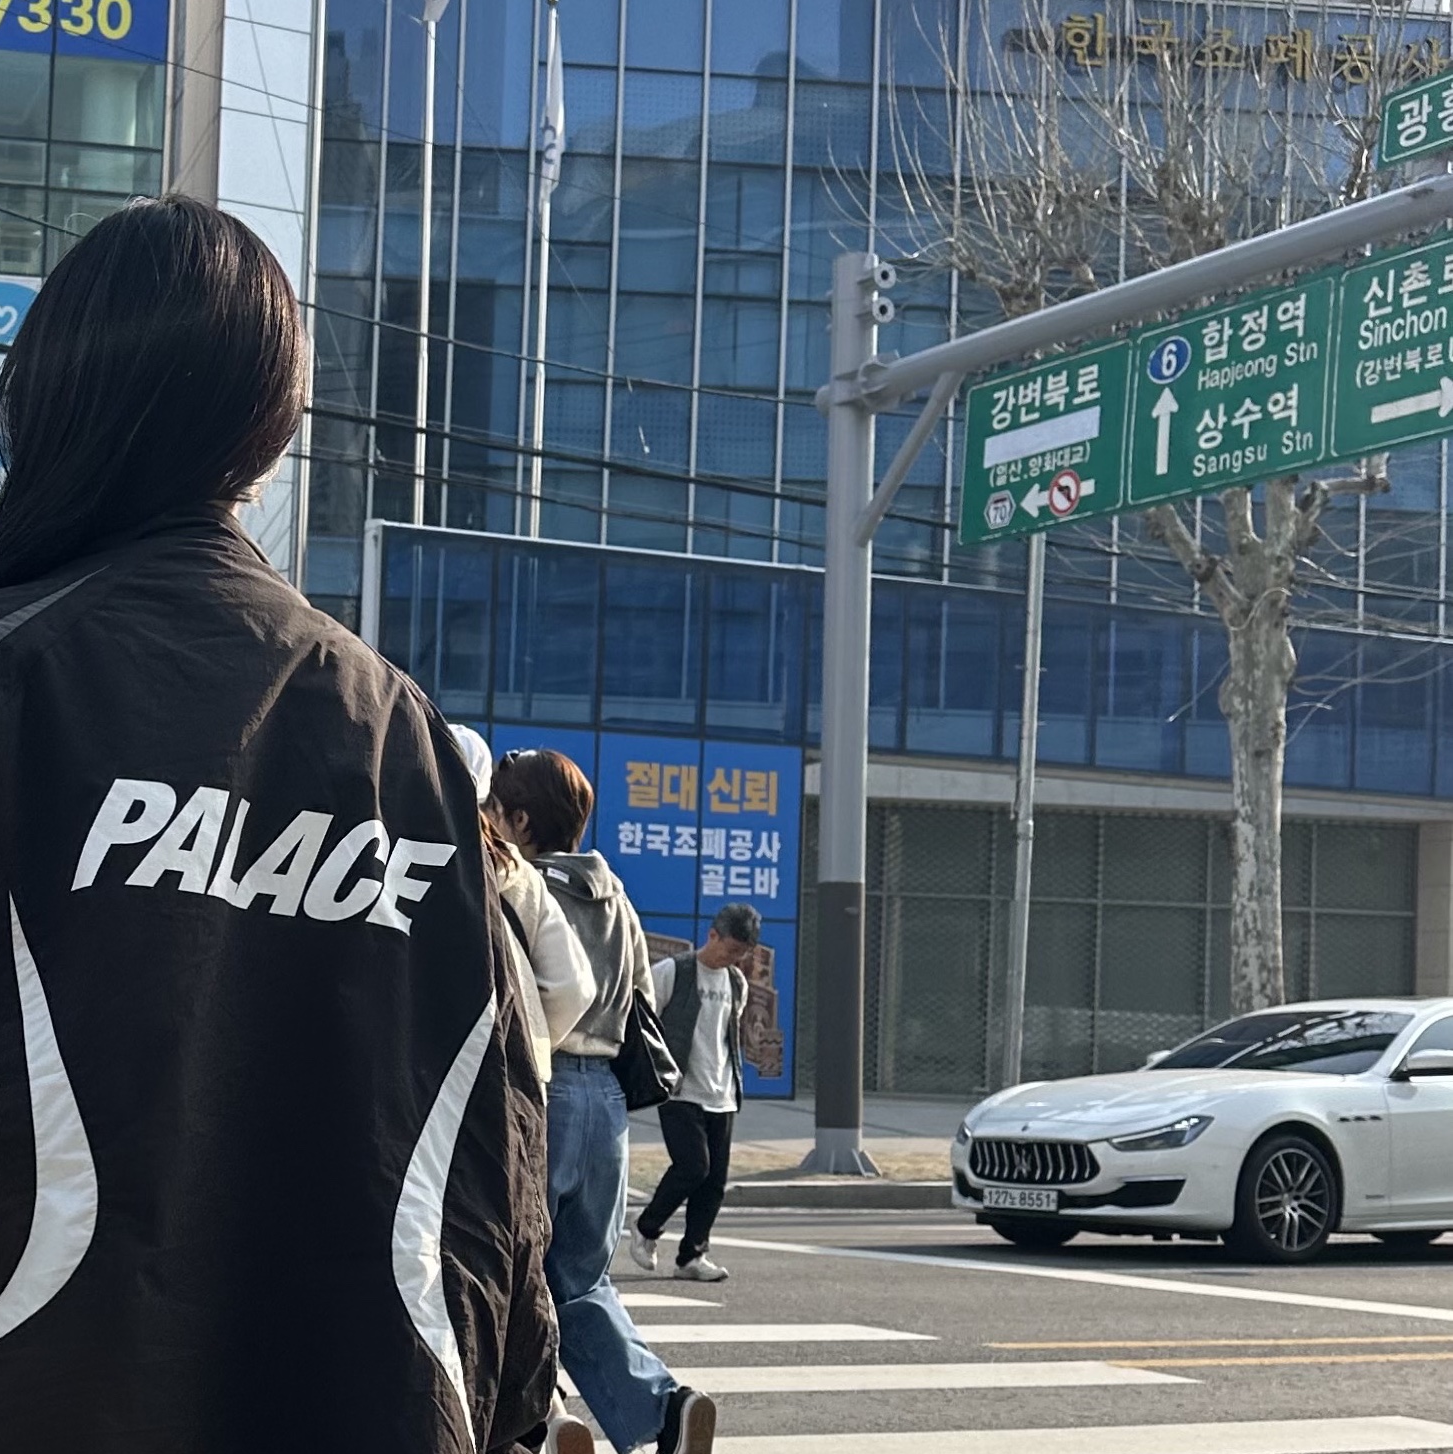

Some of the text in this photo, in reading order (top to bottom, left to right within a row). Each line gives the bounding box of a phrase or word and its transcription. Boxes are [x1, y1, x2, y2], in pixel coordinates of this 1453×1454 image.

[1201, 293, 1306, 364] 합정역
[1358, 306, 1447, 350] Sinchon
[1160, 343, 1178, 377] 6
[1197, 342, 1318, 391] Hapjeong Stn
[991, 363, 1102, 430] 강변북로
[1195, 383, 1299, 450] 상수역
[1192, 431, 1314, 478] Sangsu Stn
[992, 505, 1008, 522] 70
[626, 761, 778, 816] 절대 신뢰
[71, 777, 458, 938] PALACE
[618, 820, 782, 863] 한국조폐공사
[701, 863, 780, 899] 골드바
[1018, 1191, 1051, 1208] 8551
